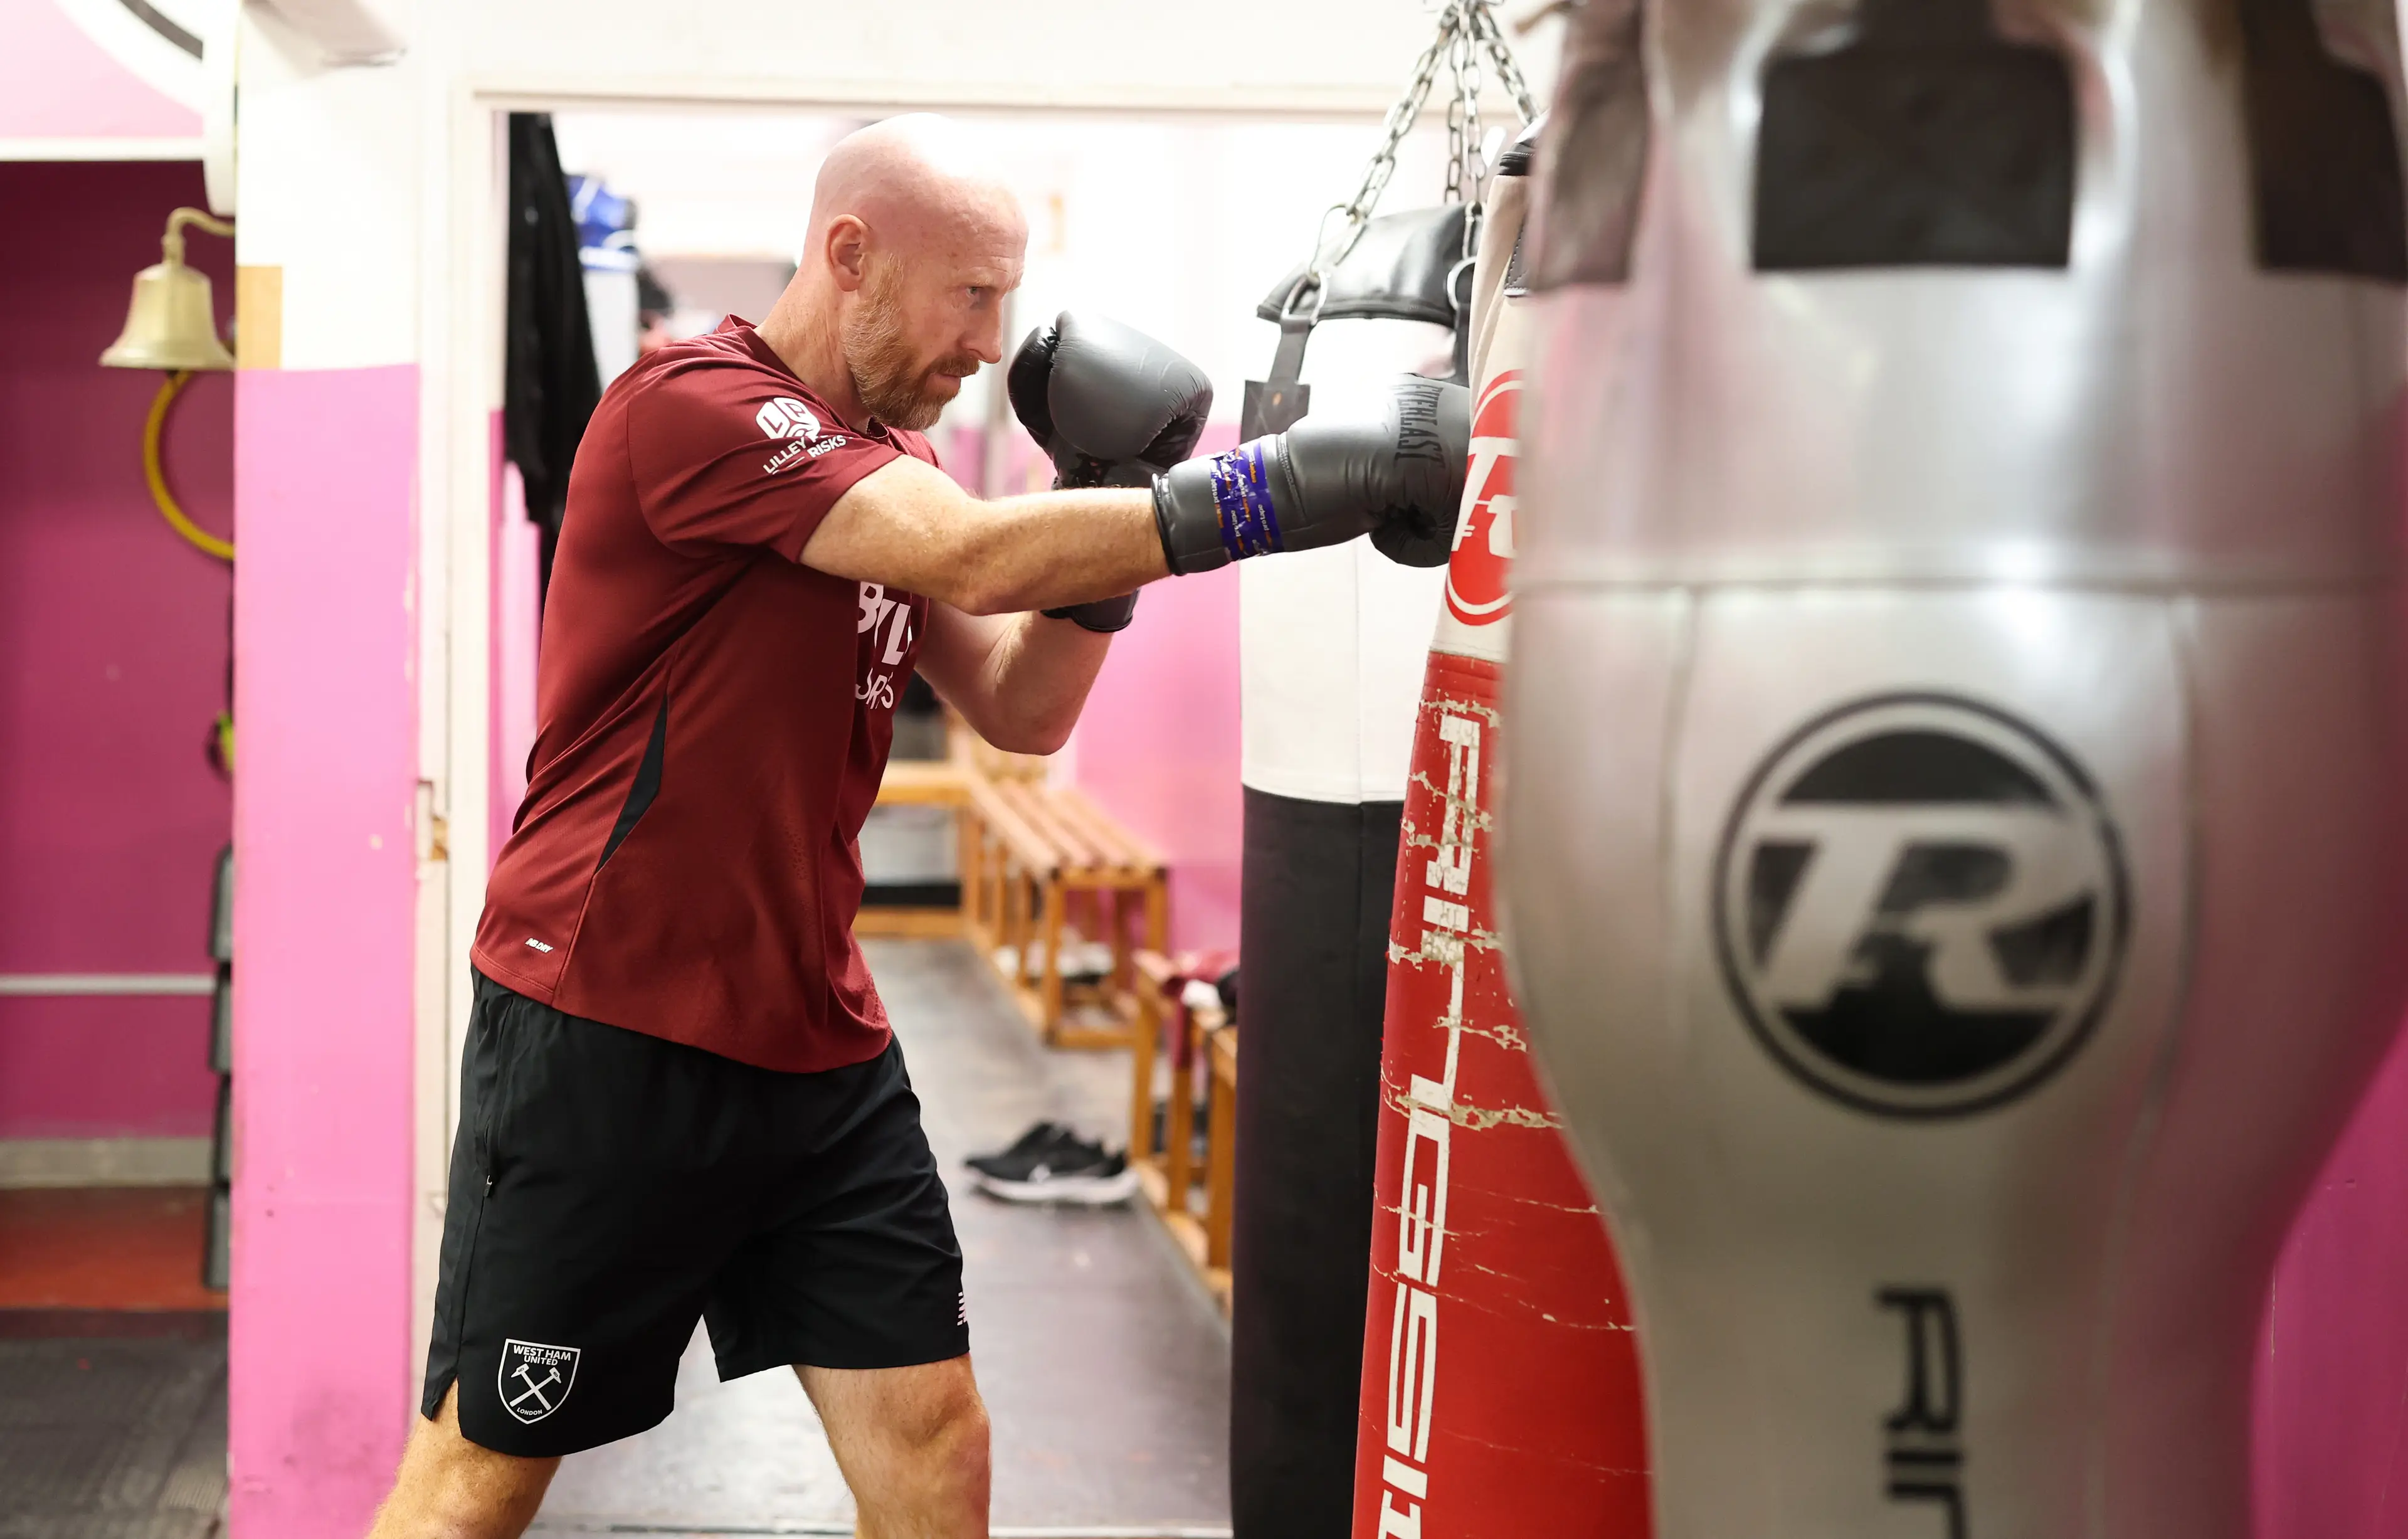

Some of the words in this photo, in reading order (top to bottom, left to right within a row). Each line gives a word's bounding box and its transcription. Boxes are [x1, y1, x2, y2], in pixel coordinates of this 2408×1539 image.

[1390, 384, 1446, 469] EVERLAST
[763, 437, 806, 474] LILLEY
[807, 435, 847, 458] RISKS
[513, 1345, 544, 1357] WEST
[545, 1350, 571, 1361] HAM
[524, 1355, 558, 1366] UNITED
[516, 1407, 543, 1415] LONDON
